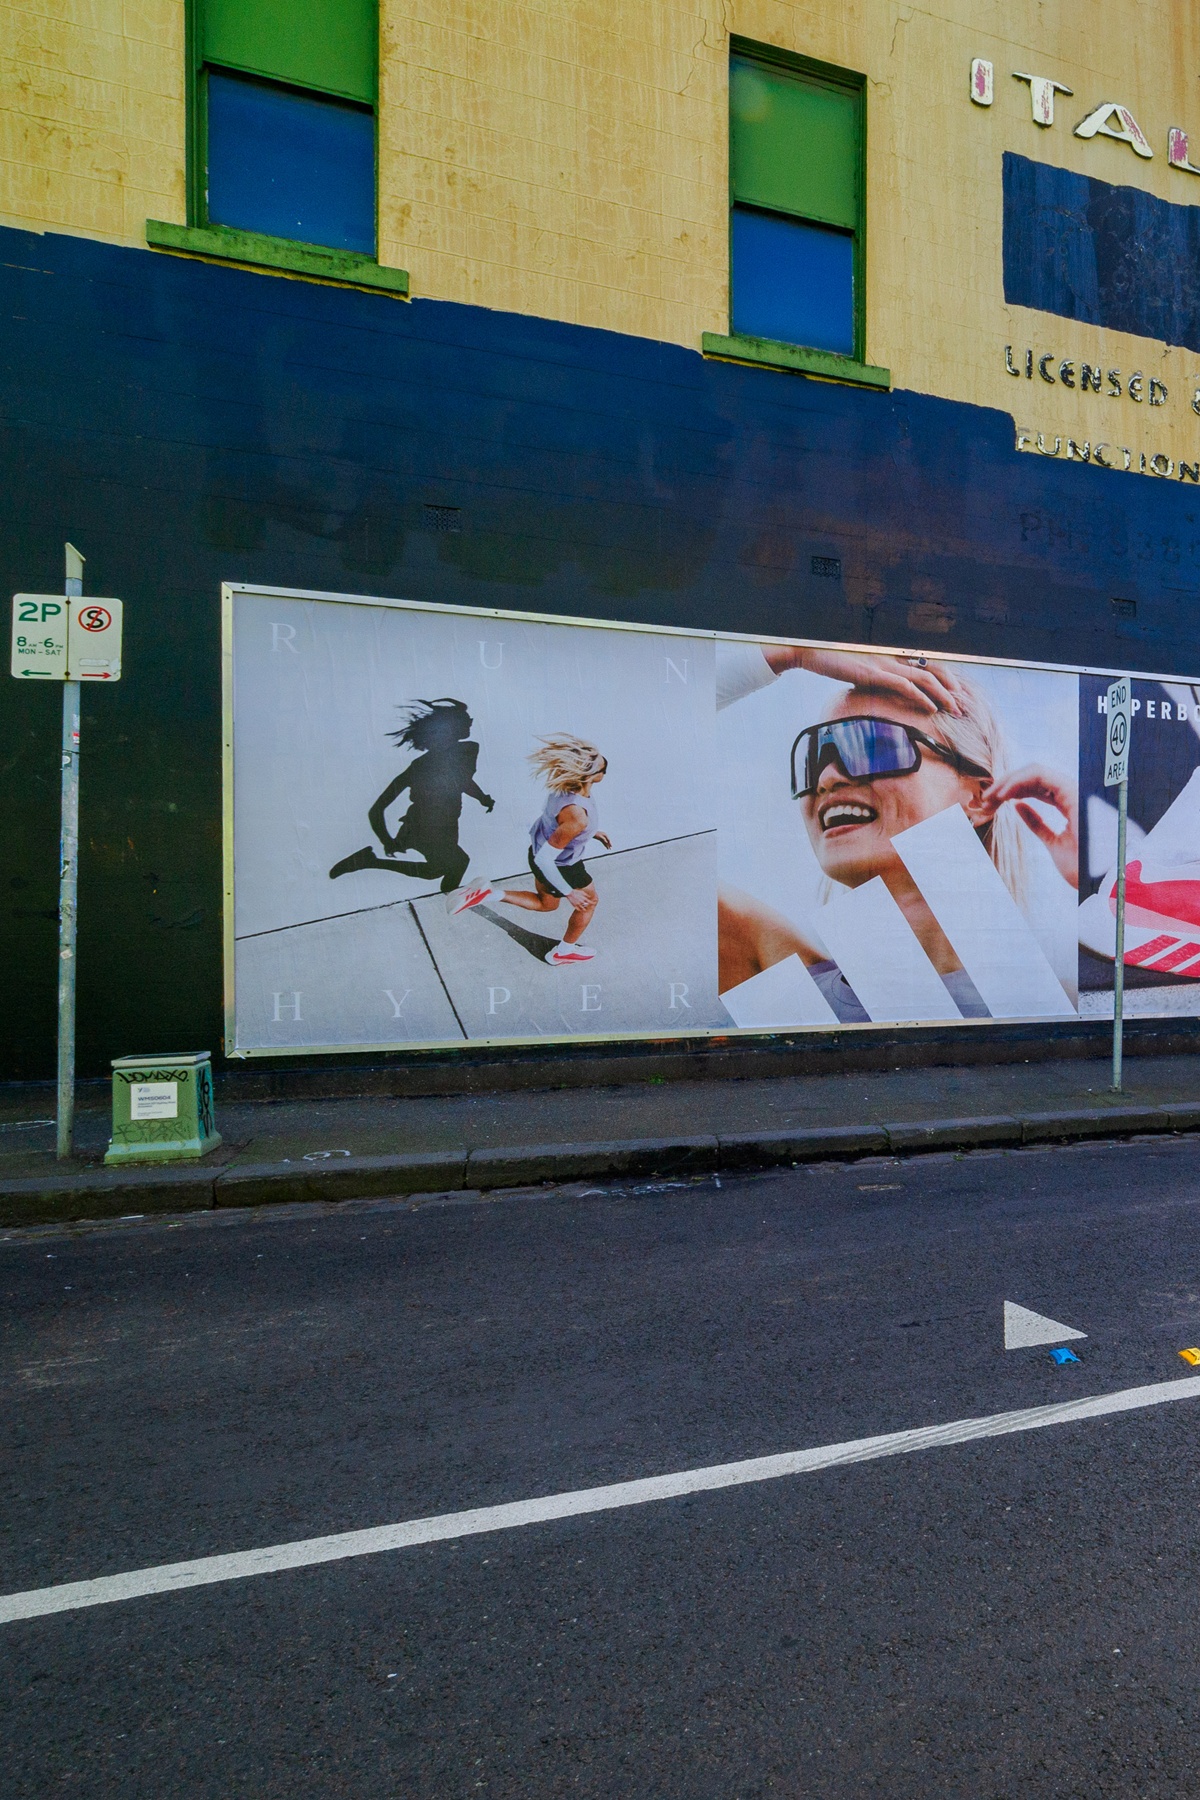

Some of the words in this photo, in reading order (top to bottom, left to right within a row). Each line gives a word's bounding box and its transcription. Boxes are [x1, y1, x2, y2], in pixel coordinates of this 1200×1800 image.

[1004, 345, 1169, 406] LICENSED
[1016, 428, 1200, 483] FUNCTION
[18, 601, 62, 622] 2P
[1111, 685, 1127, 708] END
[1112, 721, 1127, 745] 40
